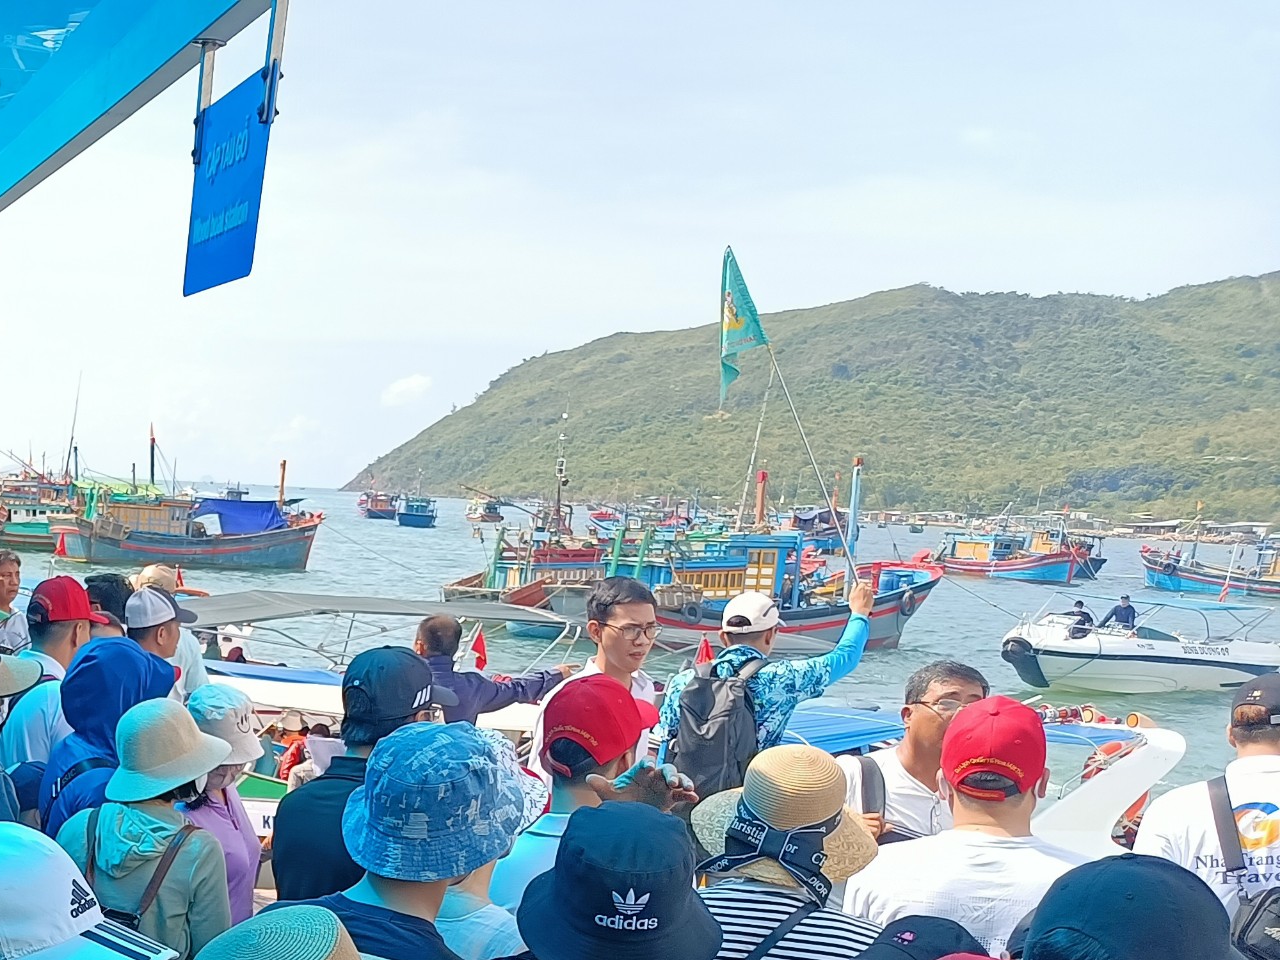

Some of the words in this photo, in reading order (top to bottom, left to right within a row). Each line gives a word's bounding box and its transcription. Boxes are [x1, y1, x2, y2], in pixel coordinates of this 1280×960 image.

[731, 818, 765, 840] hristia
[1216, 870, 1280, 885] Trave
[70, 898, 97, 918] adidas
[594, 914, 658, 931] adidas
